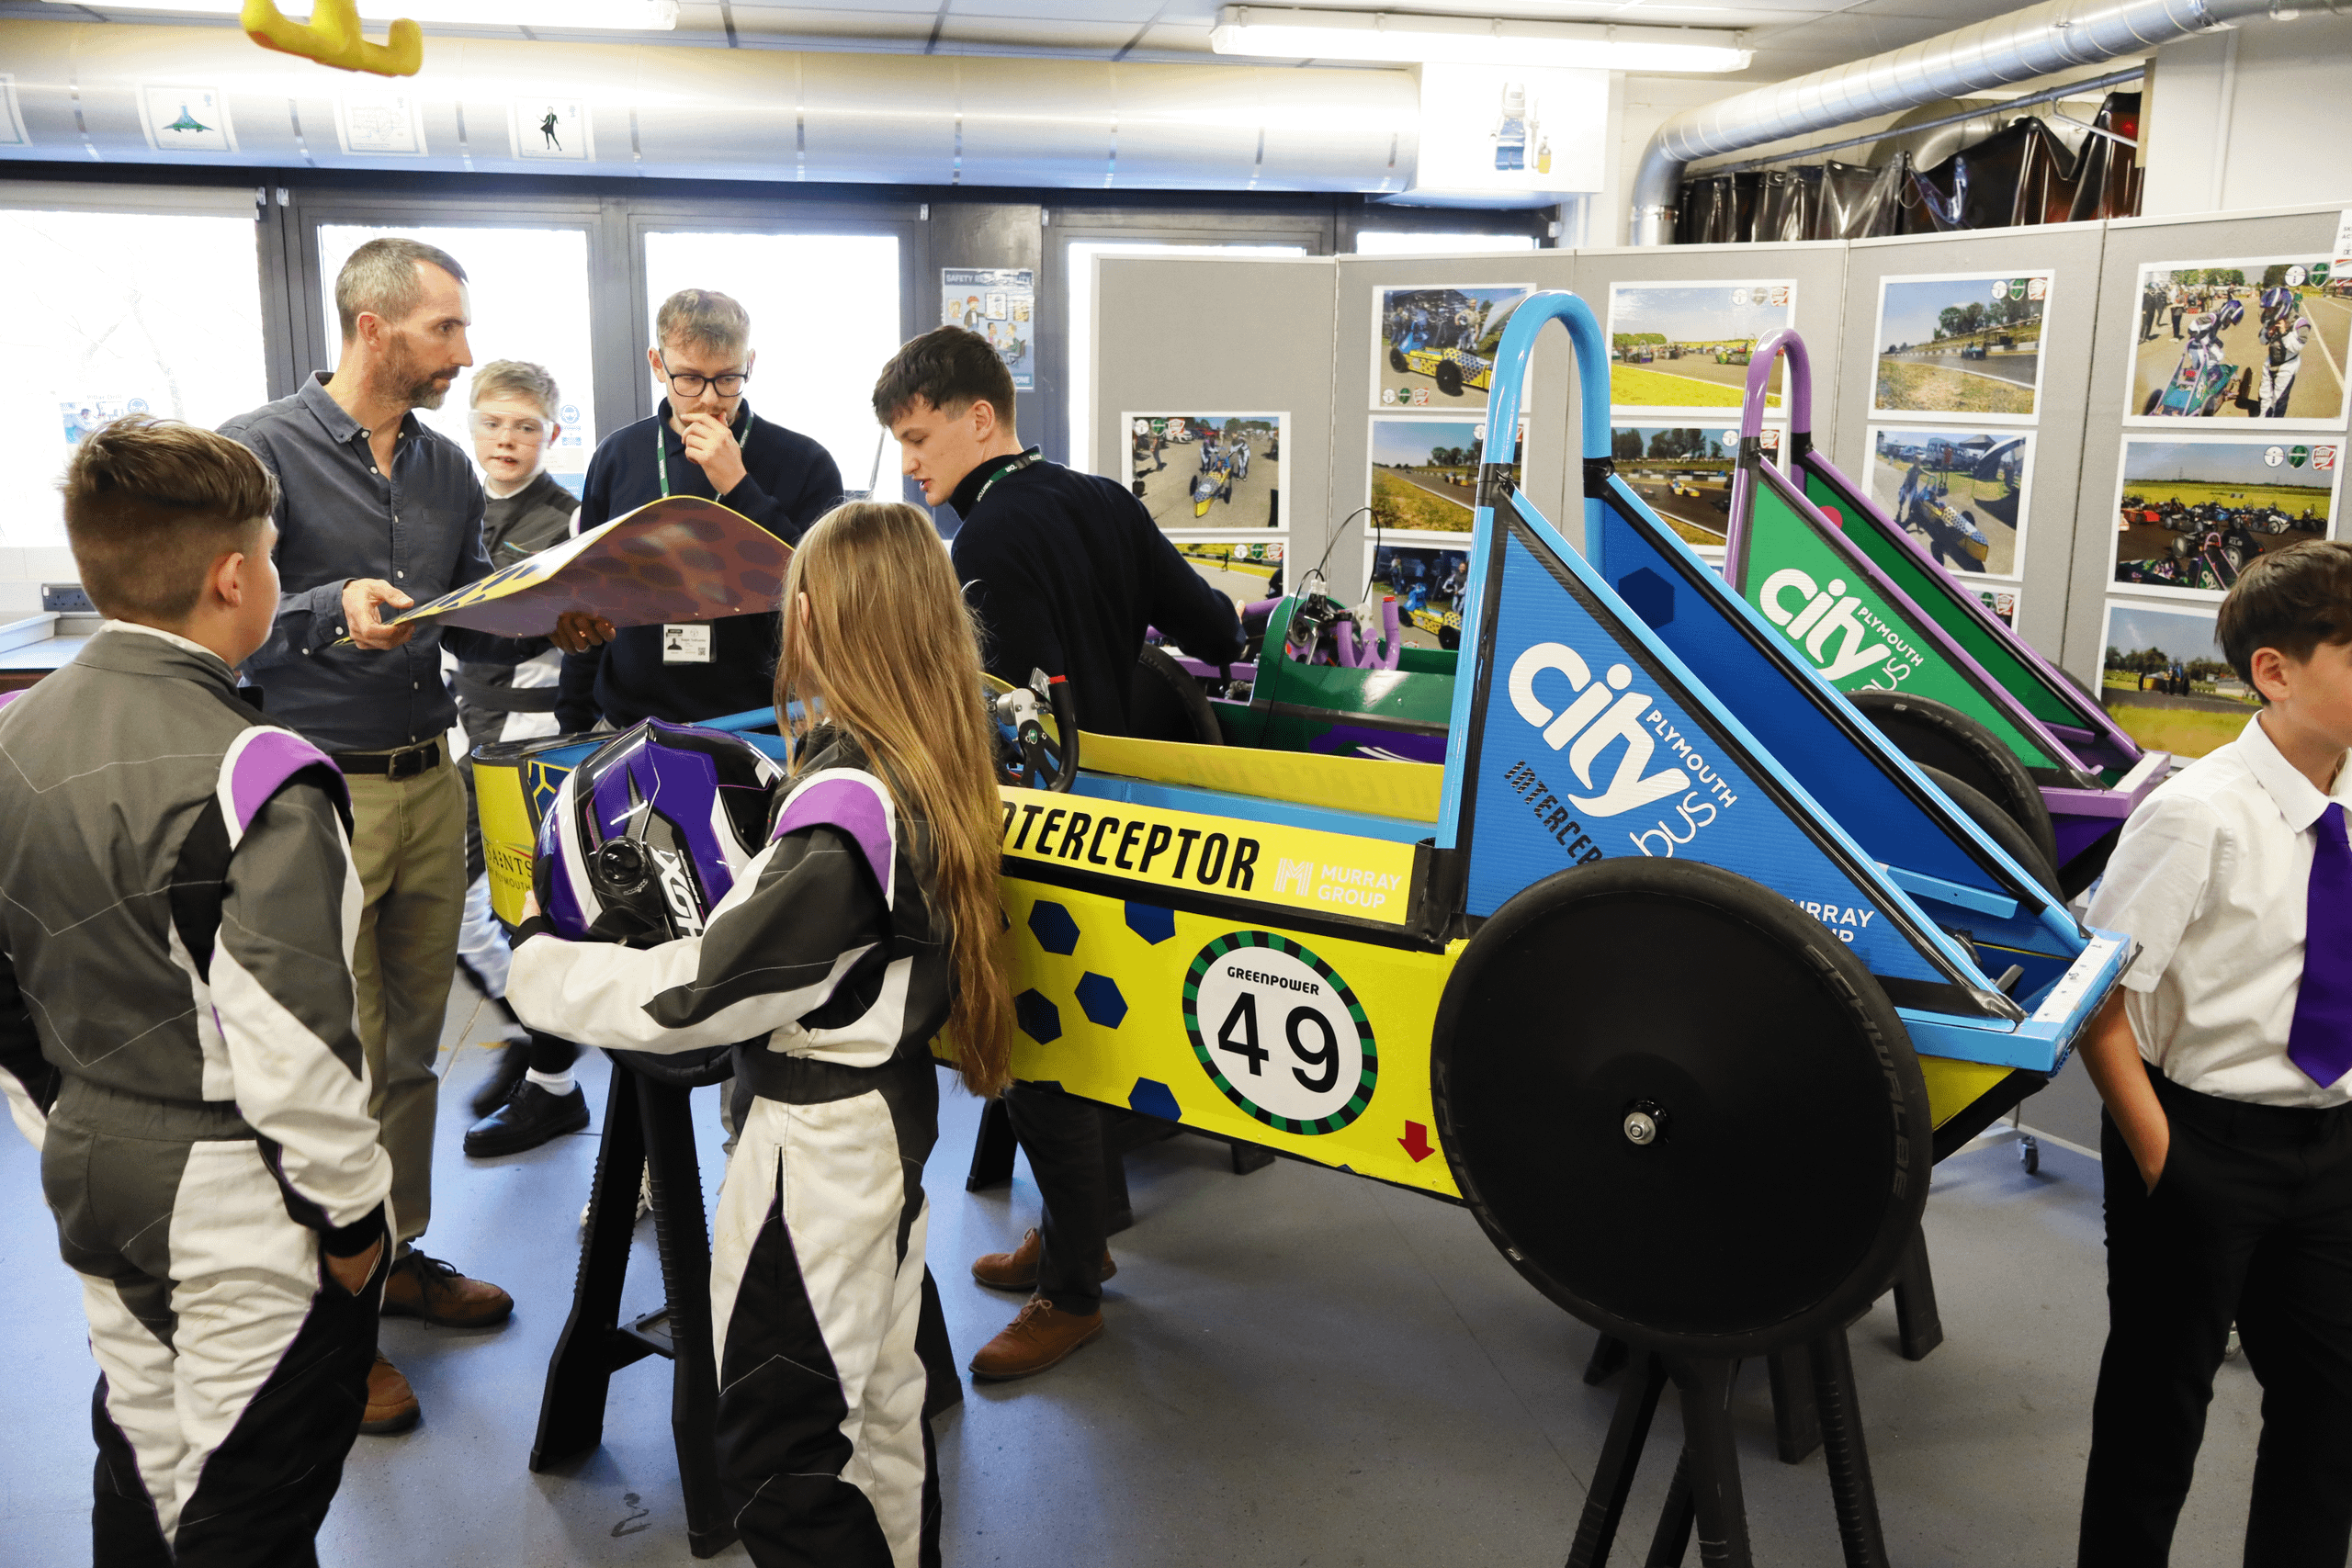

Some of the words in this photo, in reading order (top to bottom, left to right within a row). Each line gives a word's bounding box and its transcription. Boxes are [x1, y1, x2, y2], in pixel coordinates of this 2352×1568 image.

[946, 274, 974, 283] SAFETY
[1857, 606, 1924, 667] PLYMOUTH
[1645, 709, 1738, 808] PLYMOUTH
[1503, 760, 1603, 865] INTERCEP
[1629, 791, 1717, 858] bus
[1001, 800, 1260, 891] TERCEPTOR
[1317, 886, 1386, 908] GROUP
[1320, 863, 1403, 891] MURRAY
[1789, 899, 1875, 928] RRAY
[1227, 965, 1320, 996] GREENPOWER
[1217, 991, 1340, 1093] 49
